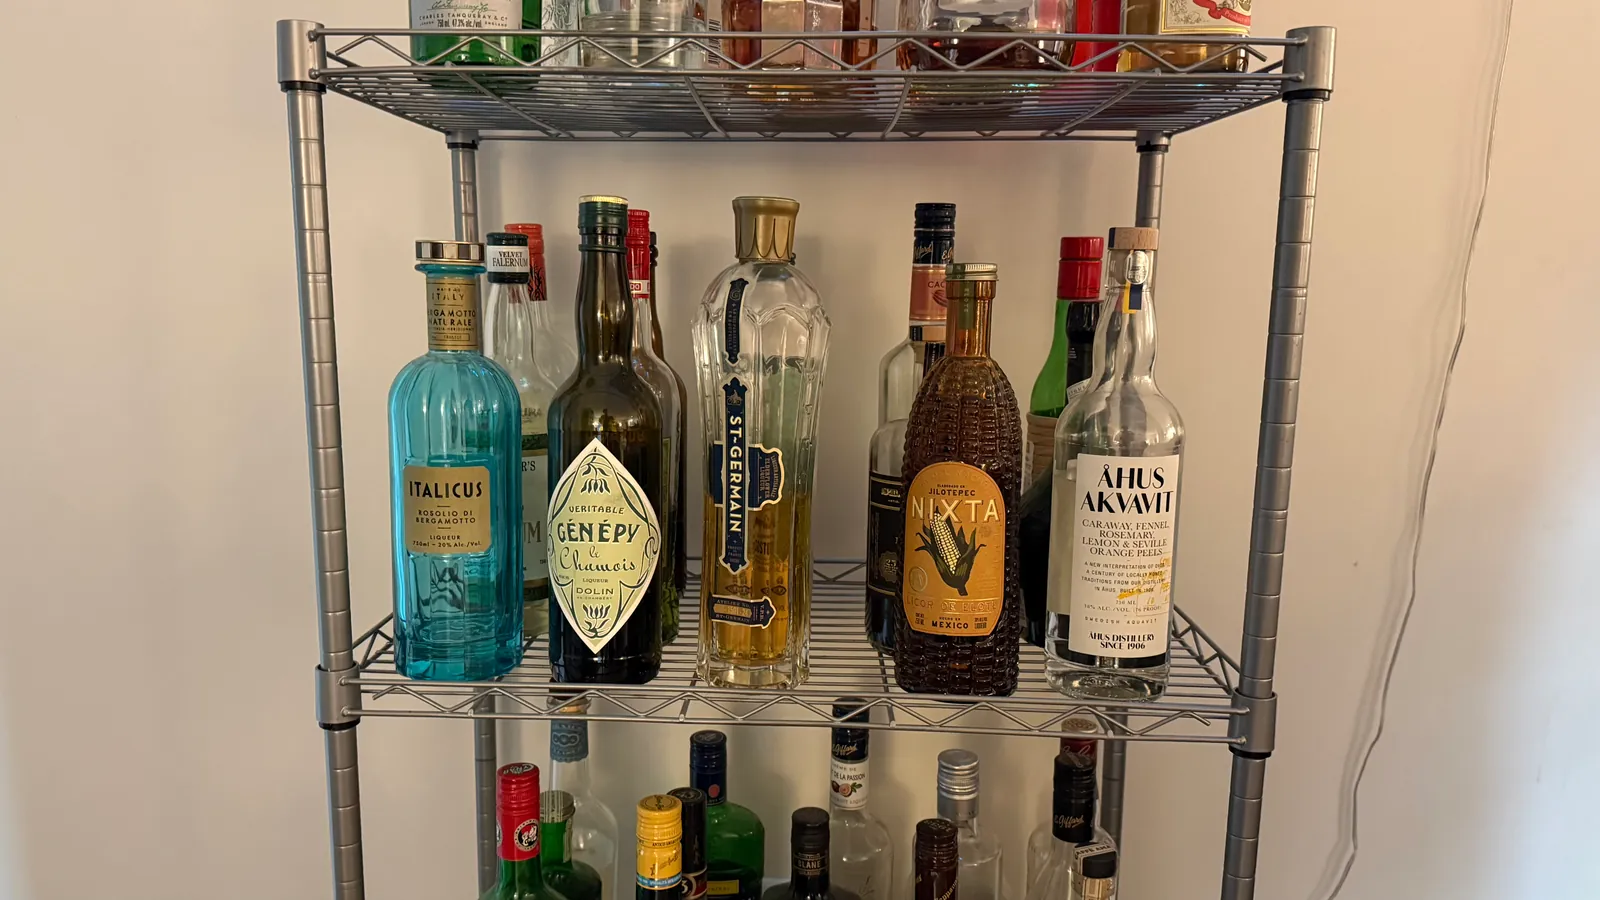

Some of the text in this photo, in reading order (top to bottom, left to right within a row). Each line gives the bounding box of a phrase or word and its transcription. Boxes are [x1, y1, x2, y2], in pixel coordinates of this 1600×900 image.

[448, 12, 492, 20] TANQUERAY
[492, 258, 528, 267] FALERNUM
[432, 293, 464, 301] ITALY
[1098, 464, 1164, 489] ÅHUS
[409, 481, 482, 498] ITALICUS
[929, 488, 975, 496] JILOTEPEC
[1080, 491, 1174, 514] AKVAVIT
[569, 505, 624, 514] VERITABLE
[912, 496, 1000, 523] NIXTA
[1082, 519, 1133, 531] CARAWAY,
[557, 519, 640, 543] GÉNÉPY
[1082, 537, 1120, 547] LEMON
[1132, 539, 1167, 548] SEVILLE
[1090, 547, 1162, 557] ORANGE PEELS
[560, 546, 636, 571] Chamois
[1082, 576, 1112, 584] TRADITIONS
[907, 595, 933, 609] LICOR
[932, 621, 968, 629] MEXICO
[1085, 616, 1120, 624] SWEDISH
[1088, 631, 1154, 642] ÅHUS DISTILLERY
[847, 773, 865, 781] PASSION
[682, 881, 688, 894] 3
